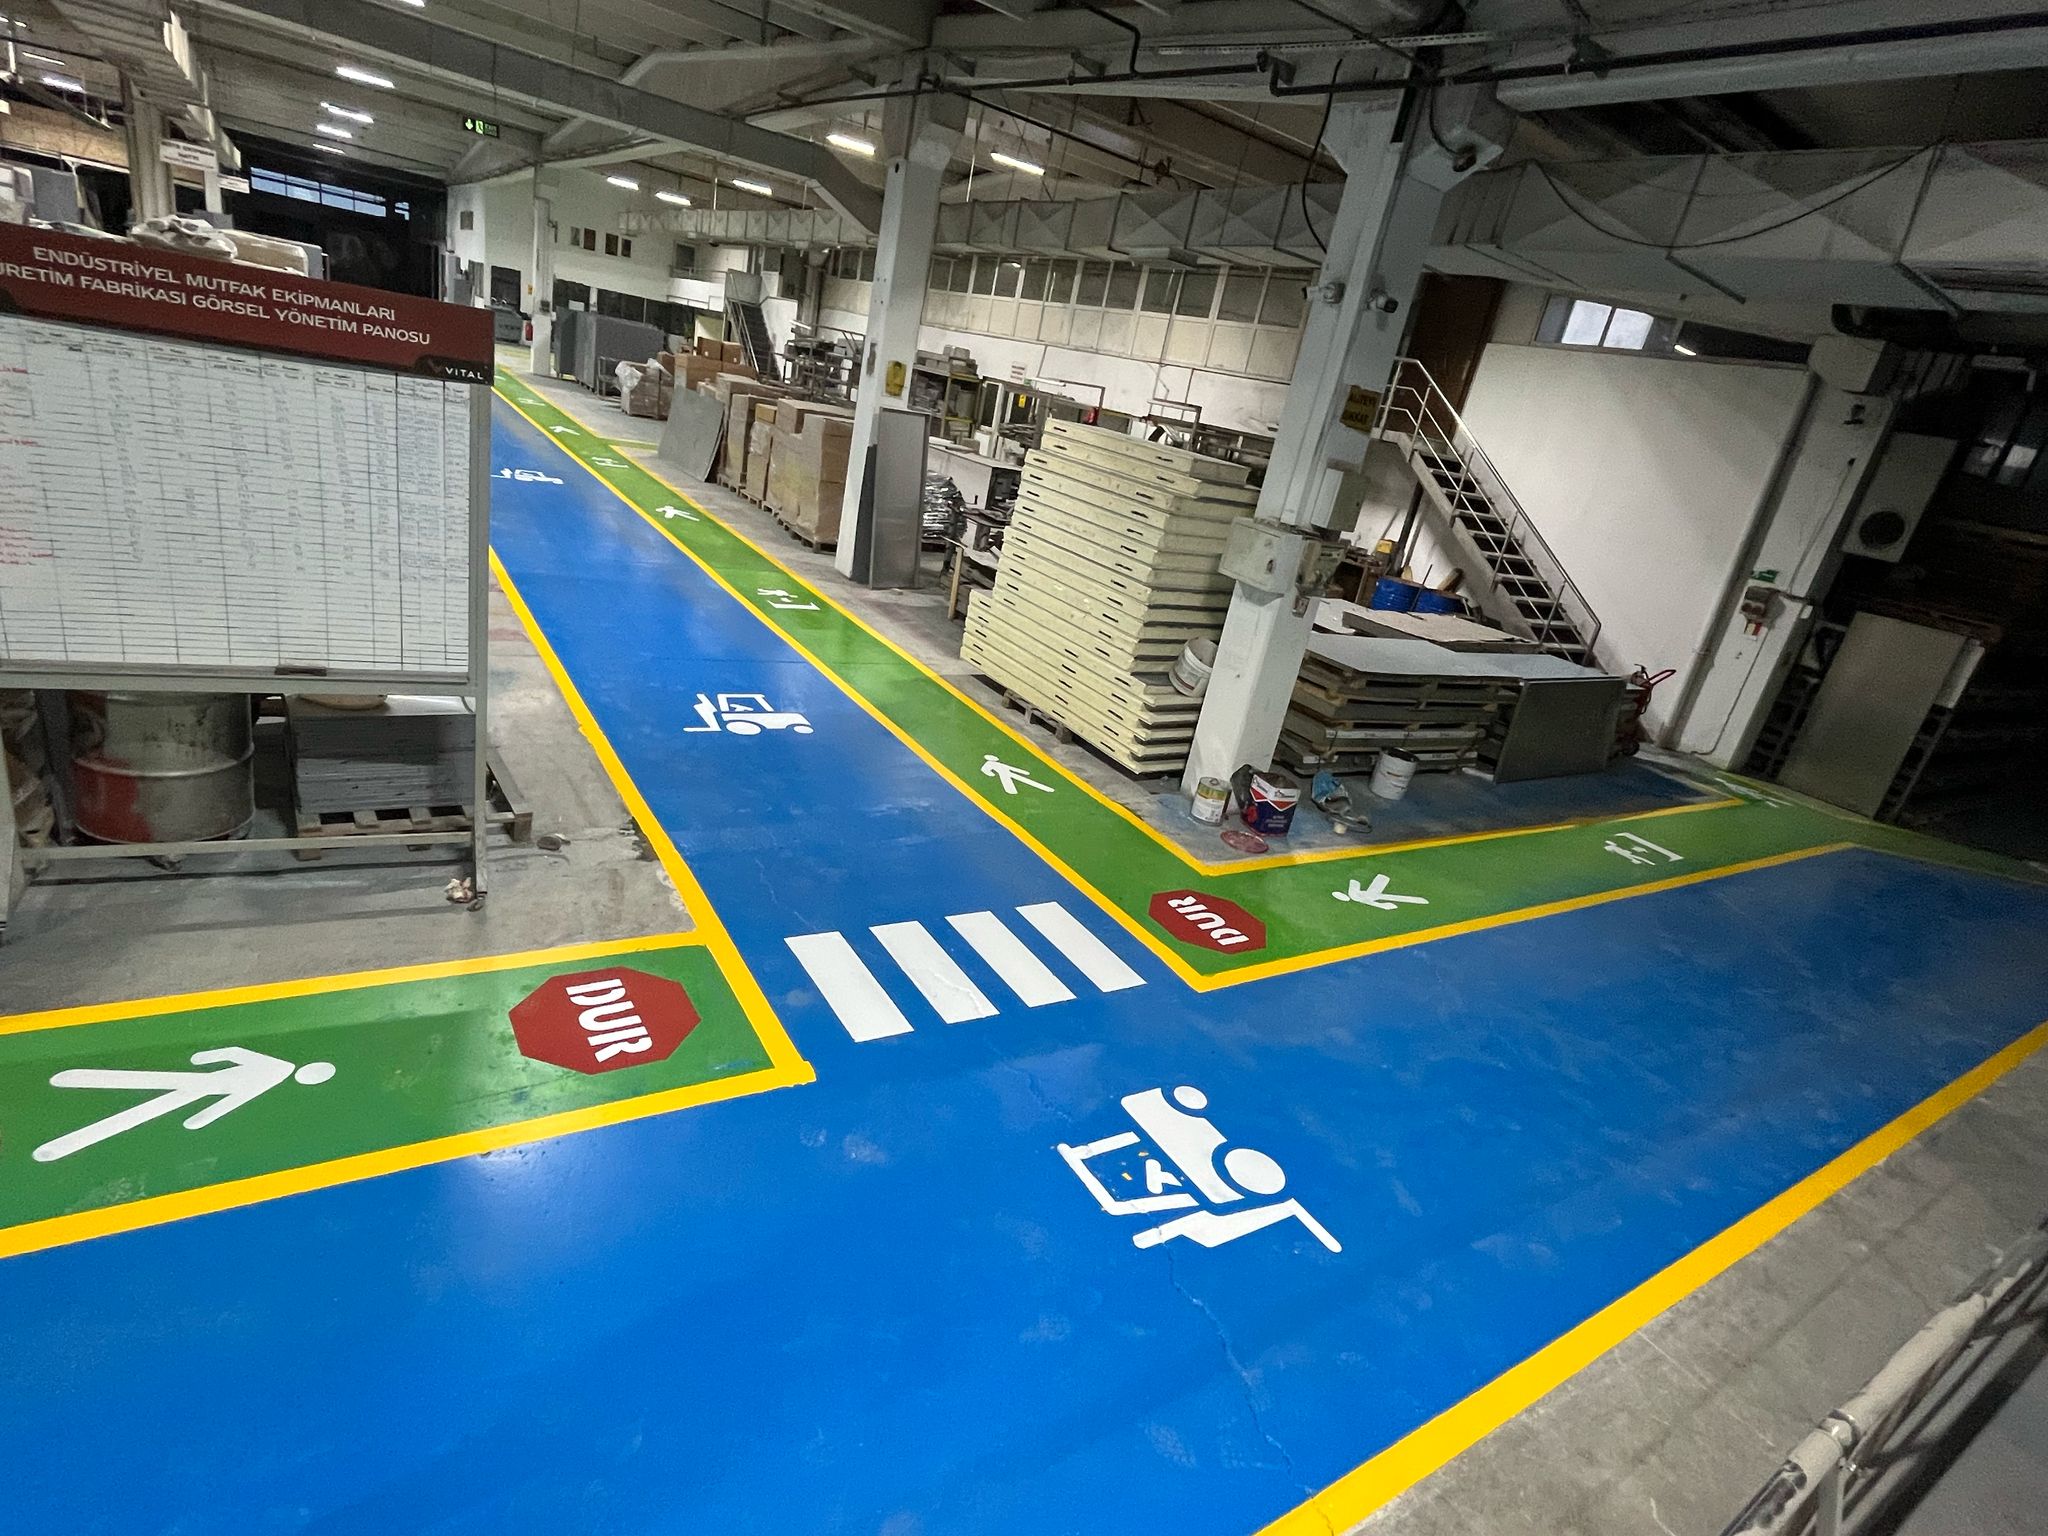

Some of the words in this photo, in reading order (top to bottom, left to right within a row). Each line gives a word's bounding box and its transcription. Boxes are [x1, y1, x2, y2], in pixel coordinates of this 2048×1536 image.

[34, 246, 181, 284] ENDÜSTRİYEL
[186, 274, 267, 299] MUTFAK
[273, 290, 395, 321] EKİPMANLARI
[80, 275, 186, 305] FABRİKASI
[192, 293, 270, 319] GÖRSEL
[276, 308, 358, 334] YÖNETİM
[363, 325, 431, 345] PANOSU
[446, 367, 484, 380] VITAL
[1167, 895, 1250, 946] DUR
[566, 978, 653, 1063] DUR
